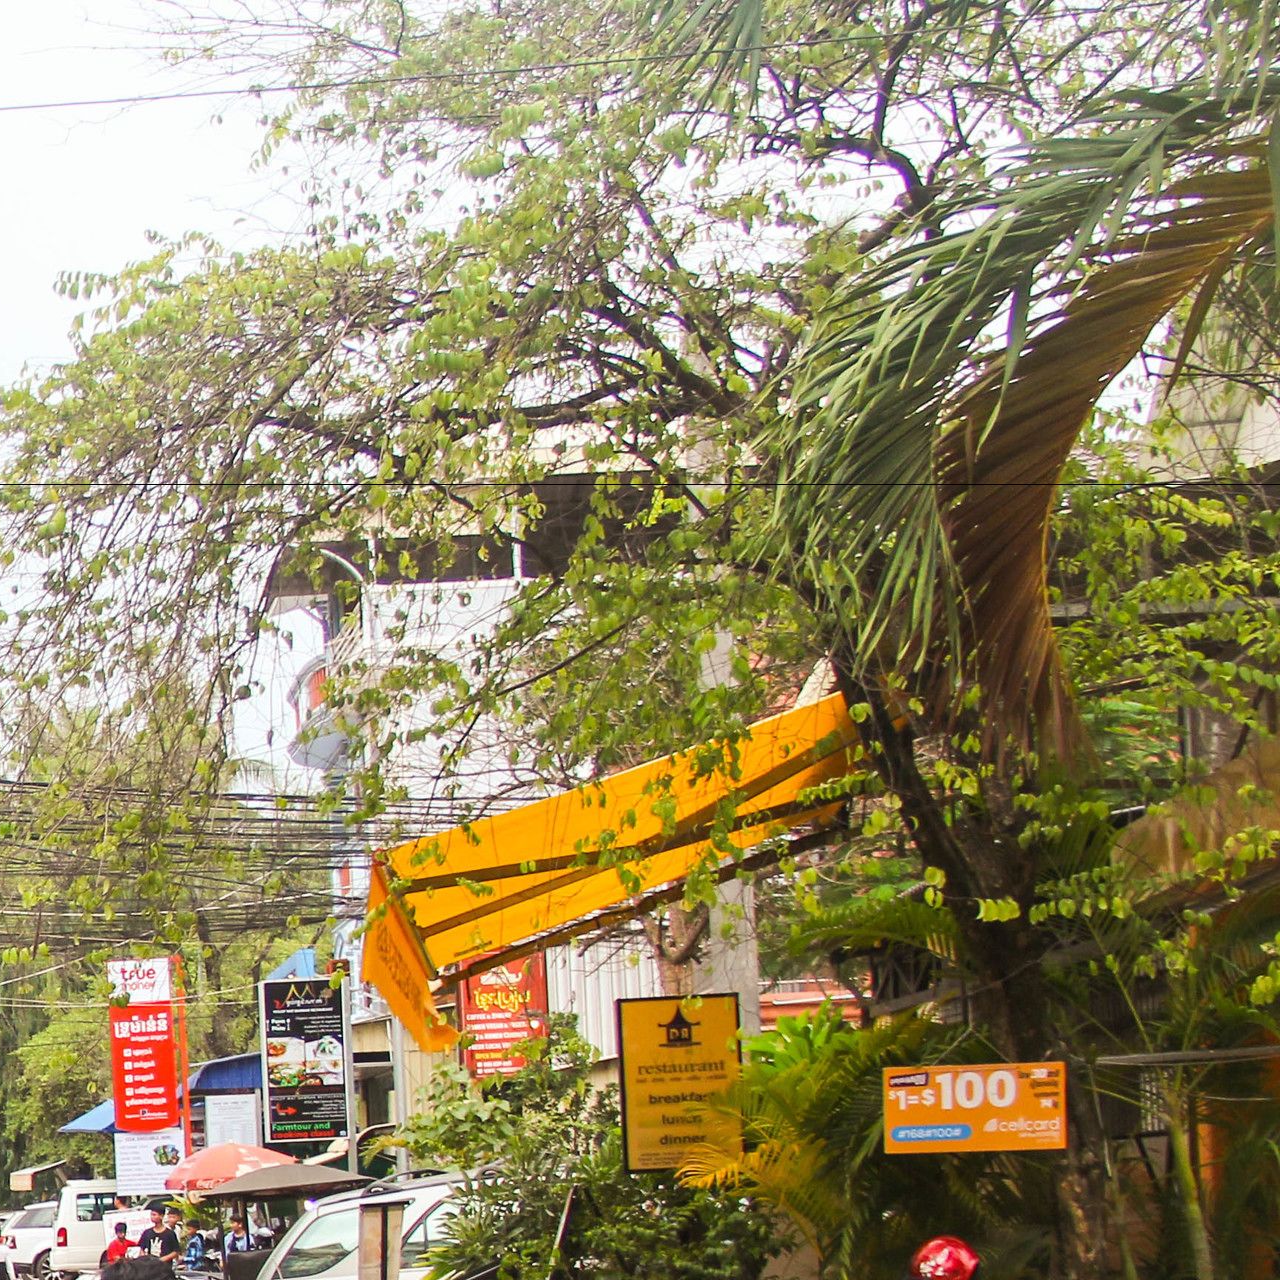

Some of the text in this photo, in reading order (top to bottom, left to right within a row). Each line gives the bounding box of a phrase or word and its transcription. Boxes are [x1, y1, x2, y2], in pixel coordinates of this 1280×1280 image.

[638, 1060, 726, 1077] restaurant
[272, 1122, 330, 1132] Farmtour and
[999, 1117, 1061, 1133] cellcard
[659, 1133, 707, 1146] dinner
